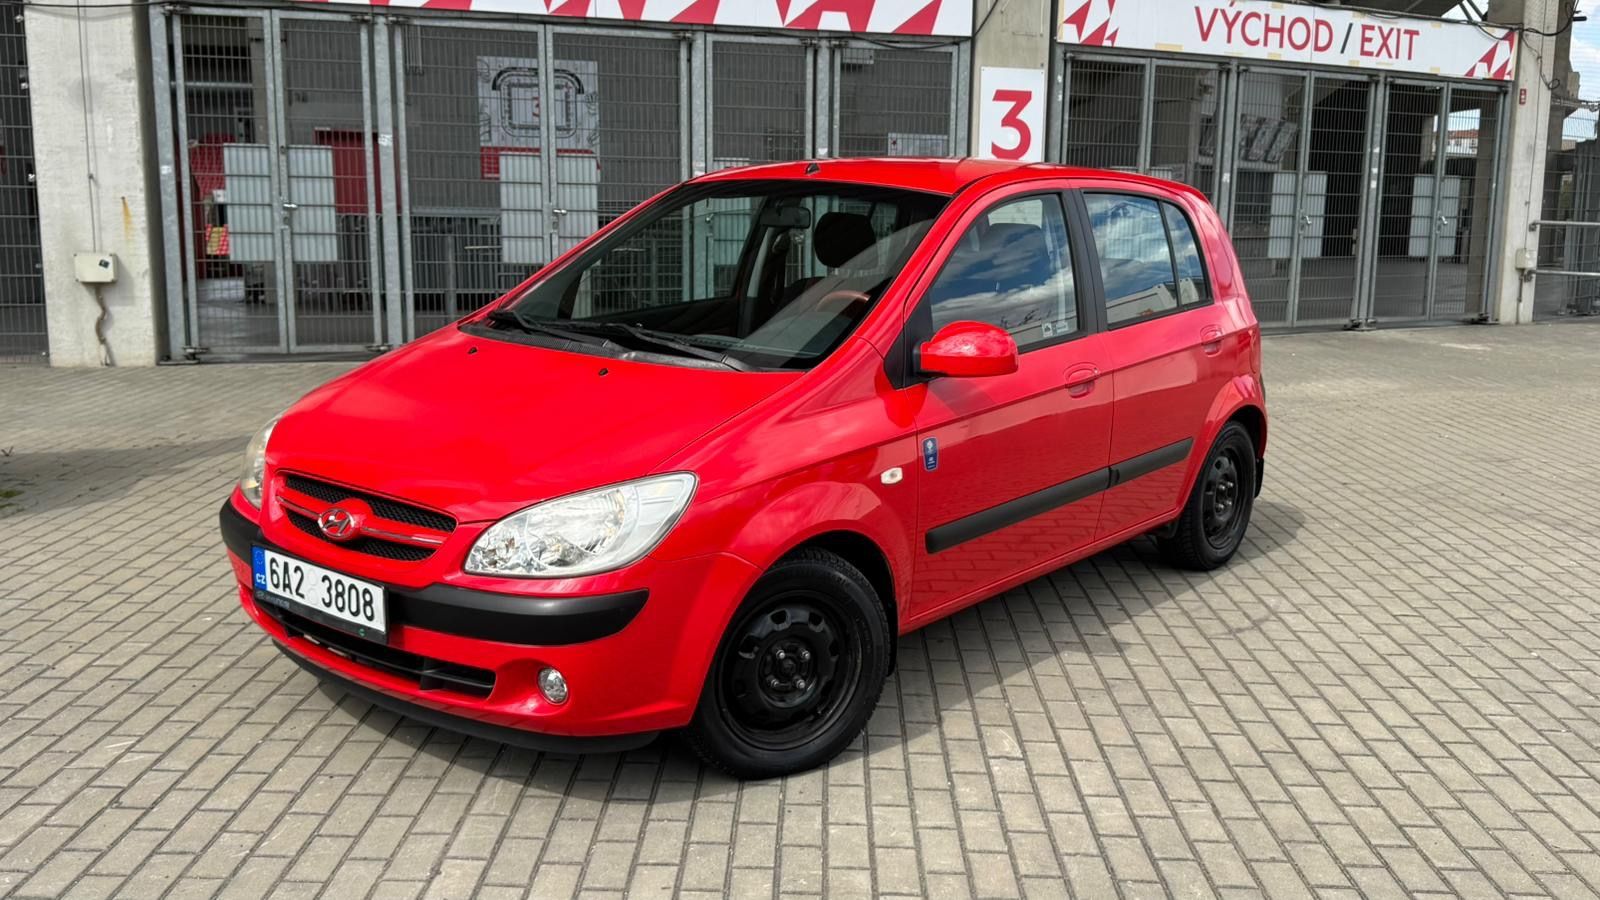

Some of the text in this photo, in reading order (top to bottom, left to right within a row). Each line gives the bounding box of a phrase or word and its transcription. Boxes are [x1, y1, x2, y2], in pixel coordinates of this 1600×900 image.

[1195, 0, 1333, 52] VÝCHOD
[1360, 24, 1420, 60] EXIT
[992, 89, 1032, 160] 3
[256, 573, 266, 584] CZ
[270, 557, 305, 599] 6A2
[321, 575, 375, 622] 3808
